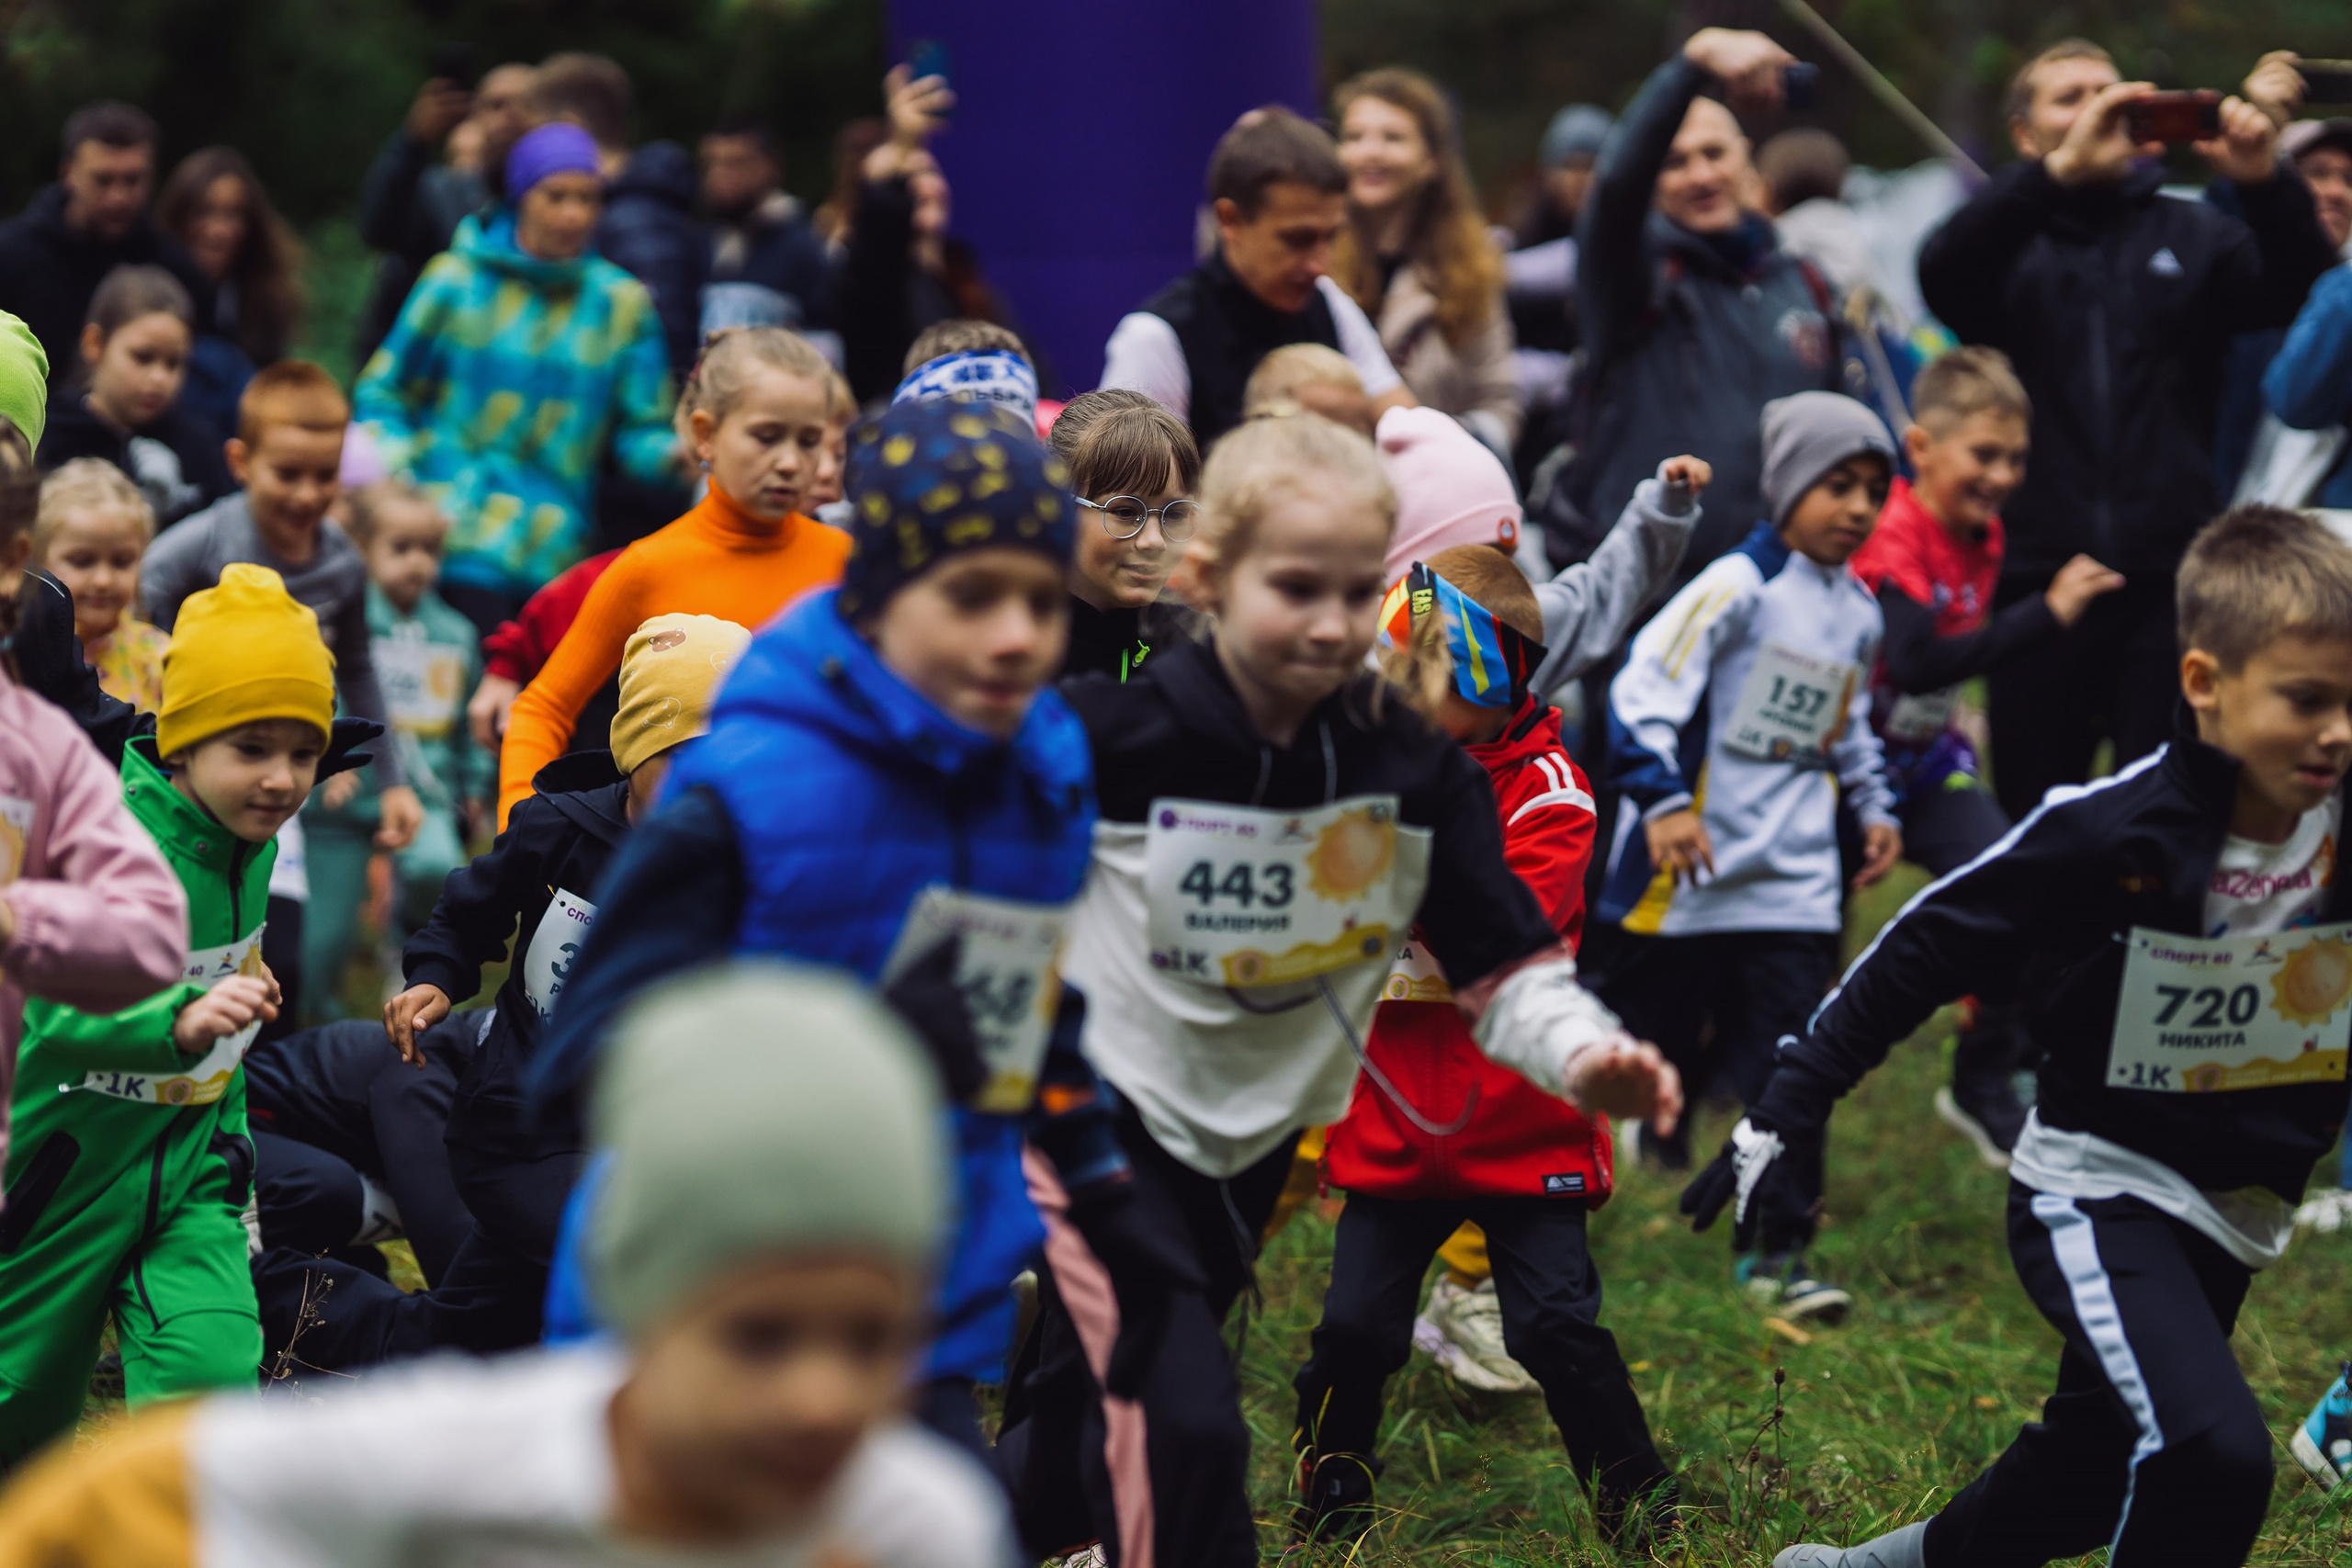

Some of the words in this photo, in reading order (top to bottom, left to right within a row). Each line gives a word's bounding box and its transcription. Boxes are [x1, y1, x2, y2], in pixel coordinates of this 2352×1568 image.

[1412, 588, 1433, 616] EAS
[1769, 675, 1829, 718] 157
[1180, 861, 1295, 908] 443
[2150, 947, 2208, 964] СПОРТ
[2154, 984, 2261, 1028] 720
[2160, 1031, 2246, 1049] НИКИТА
